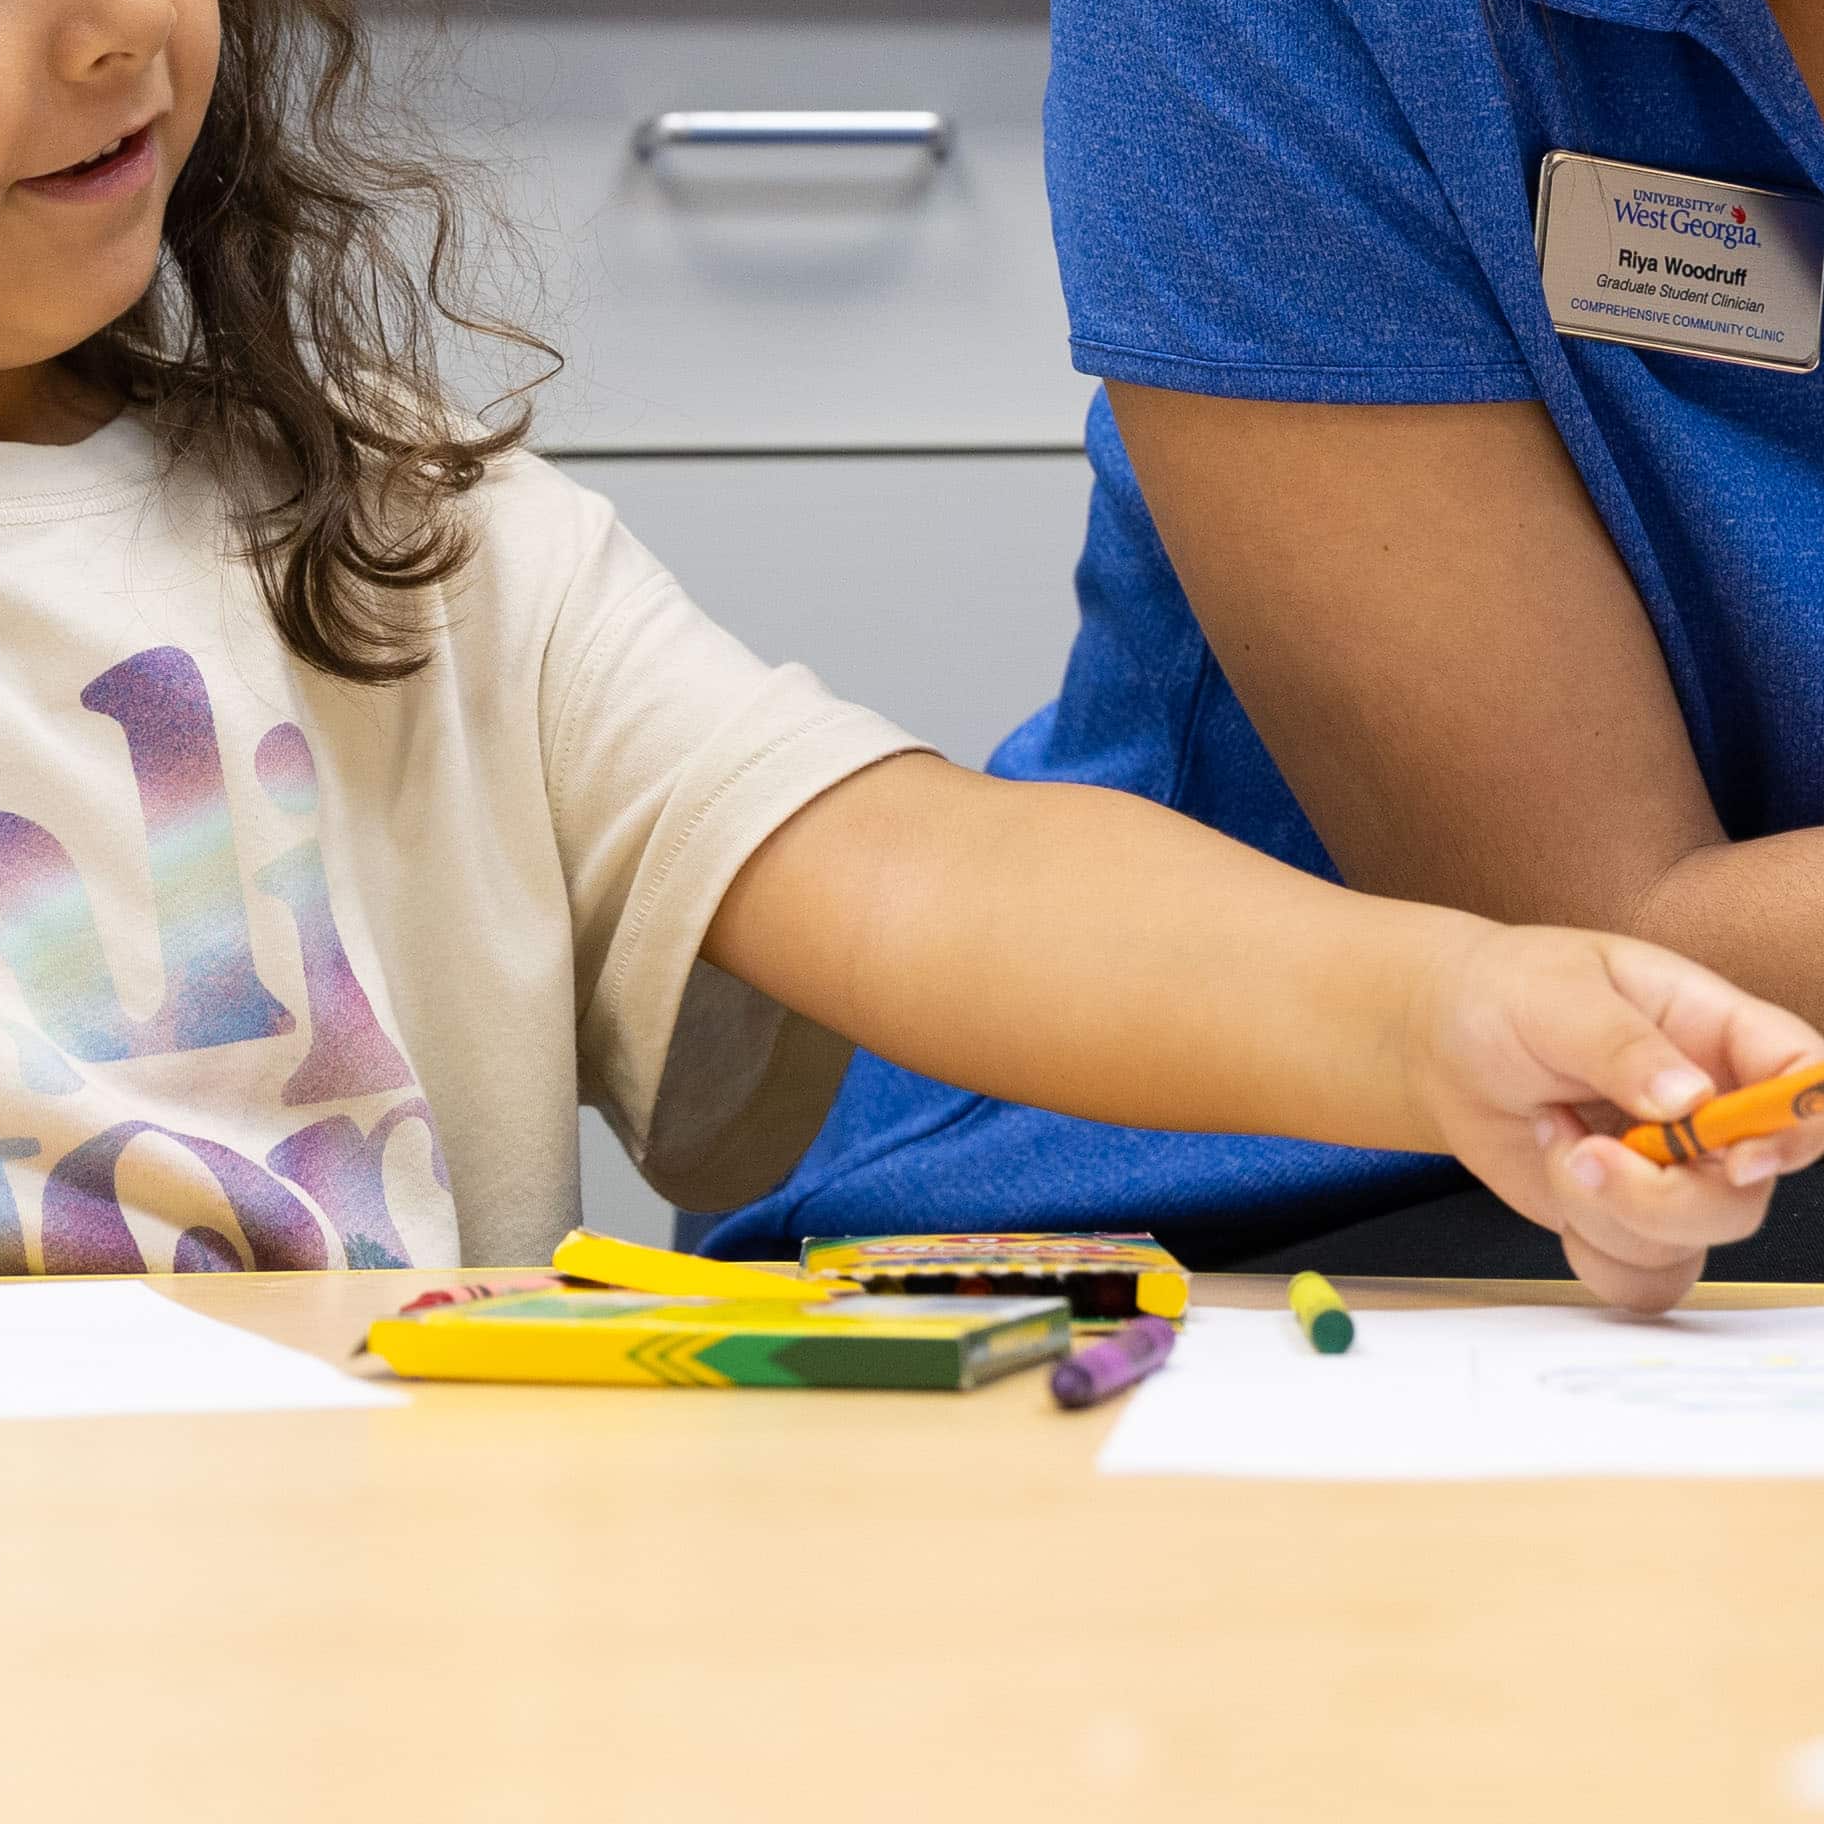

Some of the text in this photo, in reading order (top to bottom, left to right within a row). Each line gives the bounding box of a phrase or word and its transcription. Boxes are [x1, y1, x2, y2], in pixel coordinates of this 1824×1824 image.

[1632, 189, 1729, 215] UNIVERSITY of
[1613, 198, 1759, 250] West Georgia
[1618, 248, 1748, 287] Riya Woodruff
[1595, 273, 1766, 314] Graduate Student Clinician
[1570, 297, 1786, 344] COMPREHENSIVE COMMUNITY CLINIC
